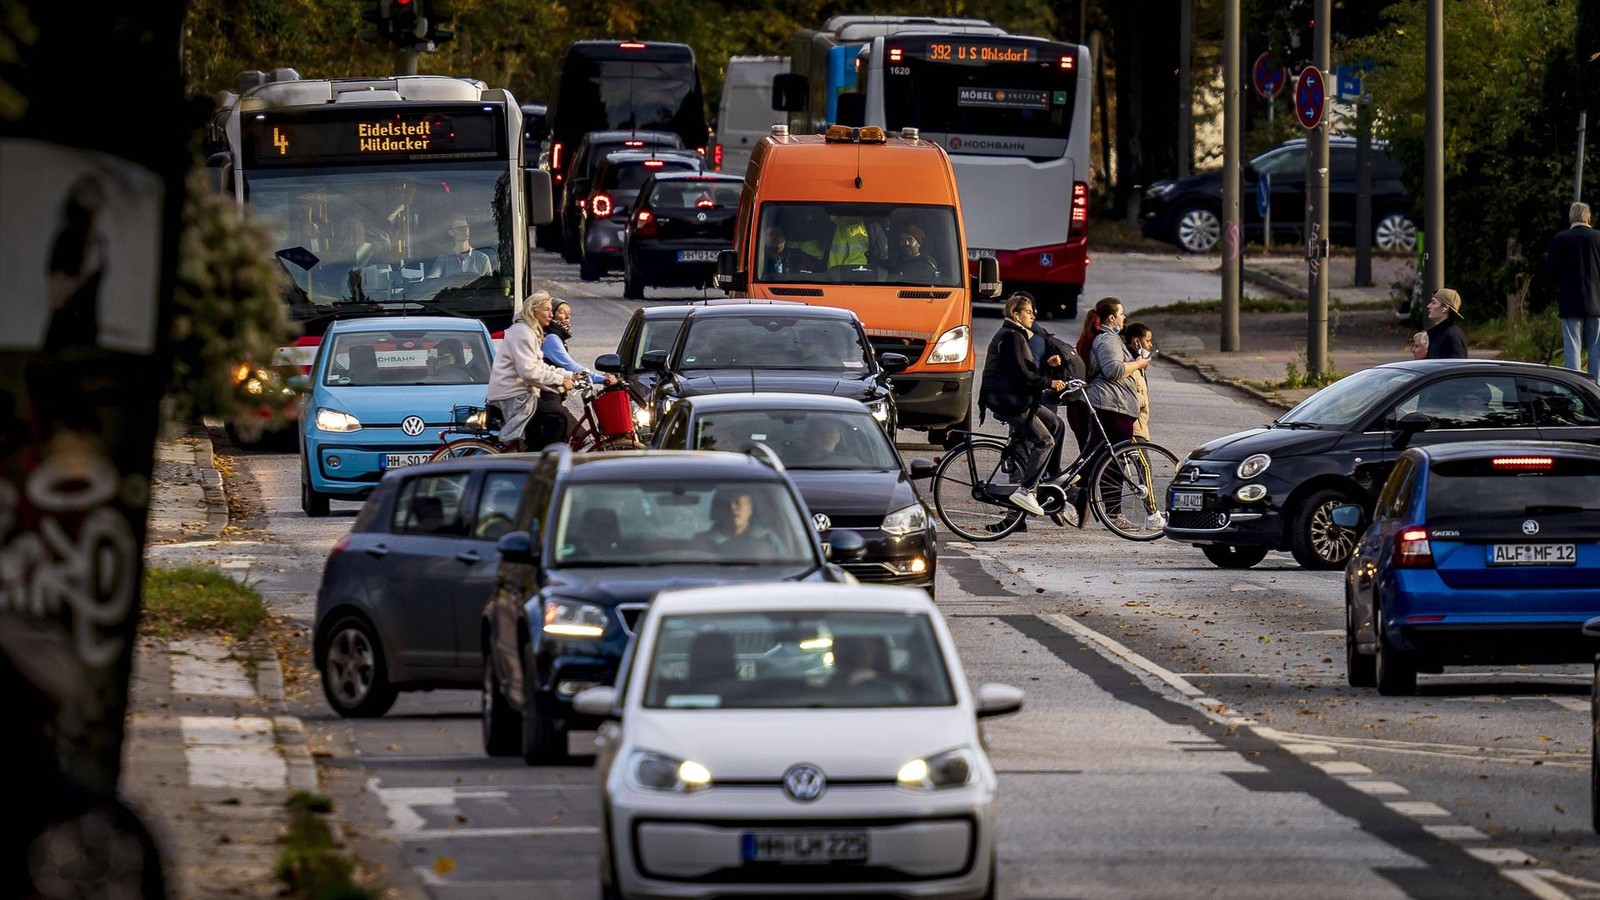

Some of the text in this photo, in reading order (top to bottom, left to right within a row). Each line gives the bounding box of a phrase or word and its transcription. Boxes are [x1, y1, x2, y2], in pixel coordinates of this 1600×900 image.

[930, 44, 1028, 62] 392 U S Ohlsdorf
[890, 67, 910, 75] 1620
[961, 91, 993, 100] MÖBEL
[358, 121, 431, 137] Eidelstedt
[273, 127, 289, 155] 4
[360, 138, 430, 152] Wildacker
[964, 140, 1025, 151] HOCHBAHN
[387, 455, 400, 467] HH
[1496, 546, 1575, 560] ALF MF 12
